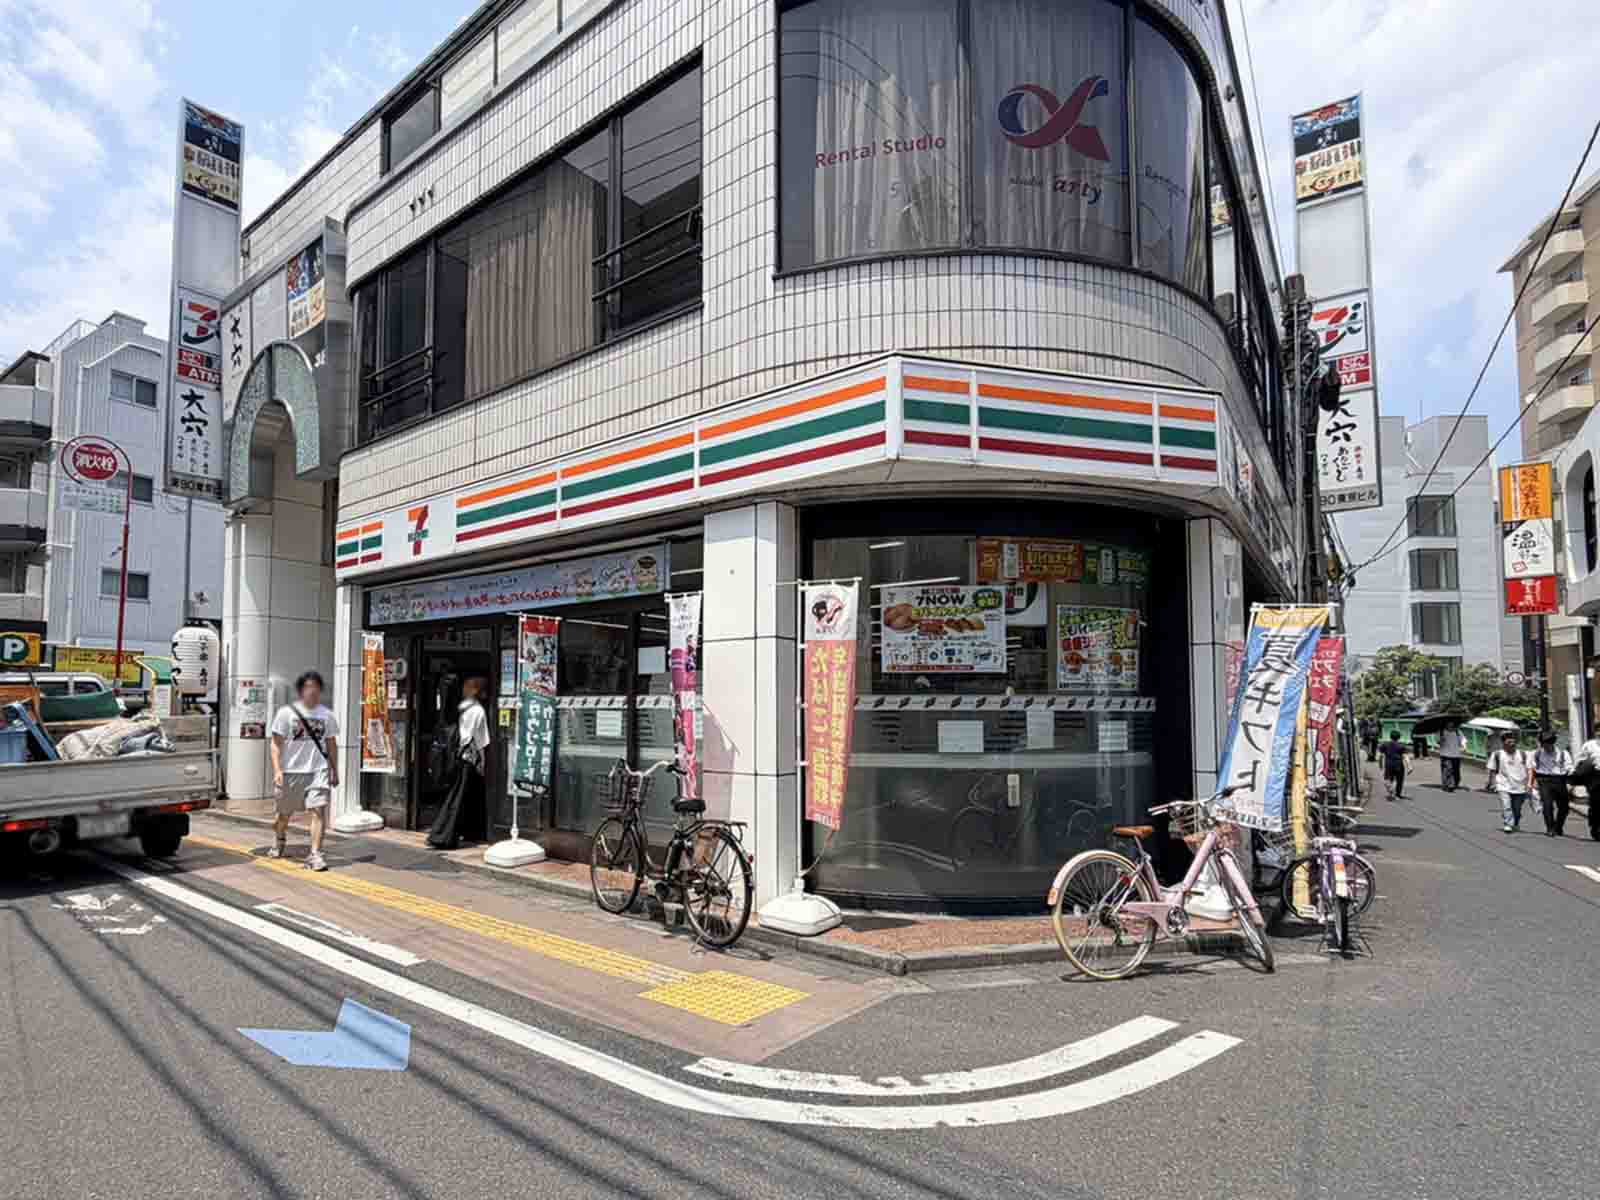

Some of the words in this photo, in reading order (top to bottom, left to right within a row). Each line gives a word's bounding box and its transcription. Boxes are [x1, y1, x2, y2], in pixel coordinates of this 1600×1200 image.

[815, 142, 876, 168] Rental
[882, 134, 946, 154] Studio
[1054, 176, 1102, 205] arty
[188, 367, 220, 384] ATM
[76, 454, 114, 472] 消火栓
[915, 594, 965, 606] 7NOW
[3, 638, 25, 660] P
